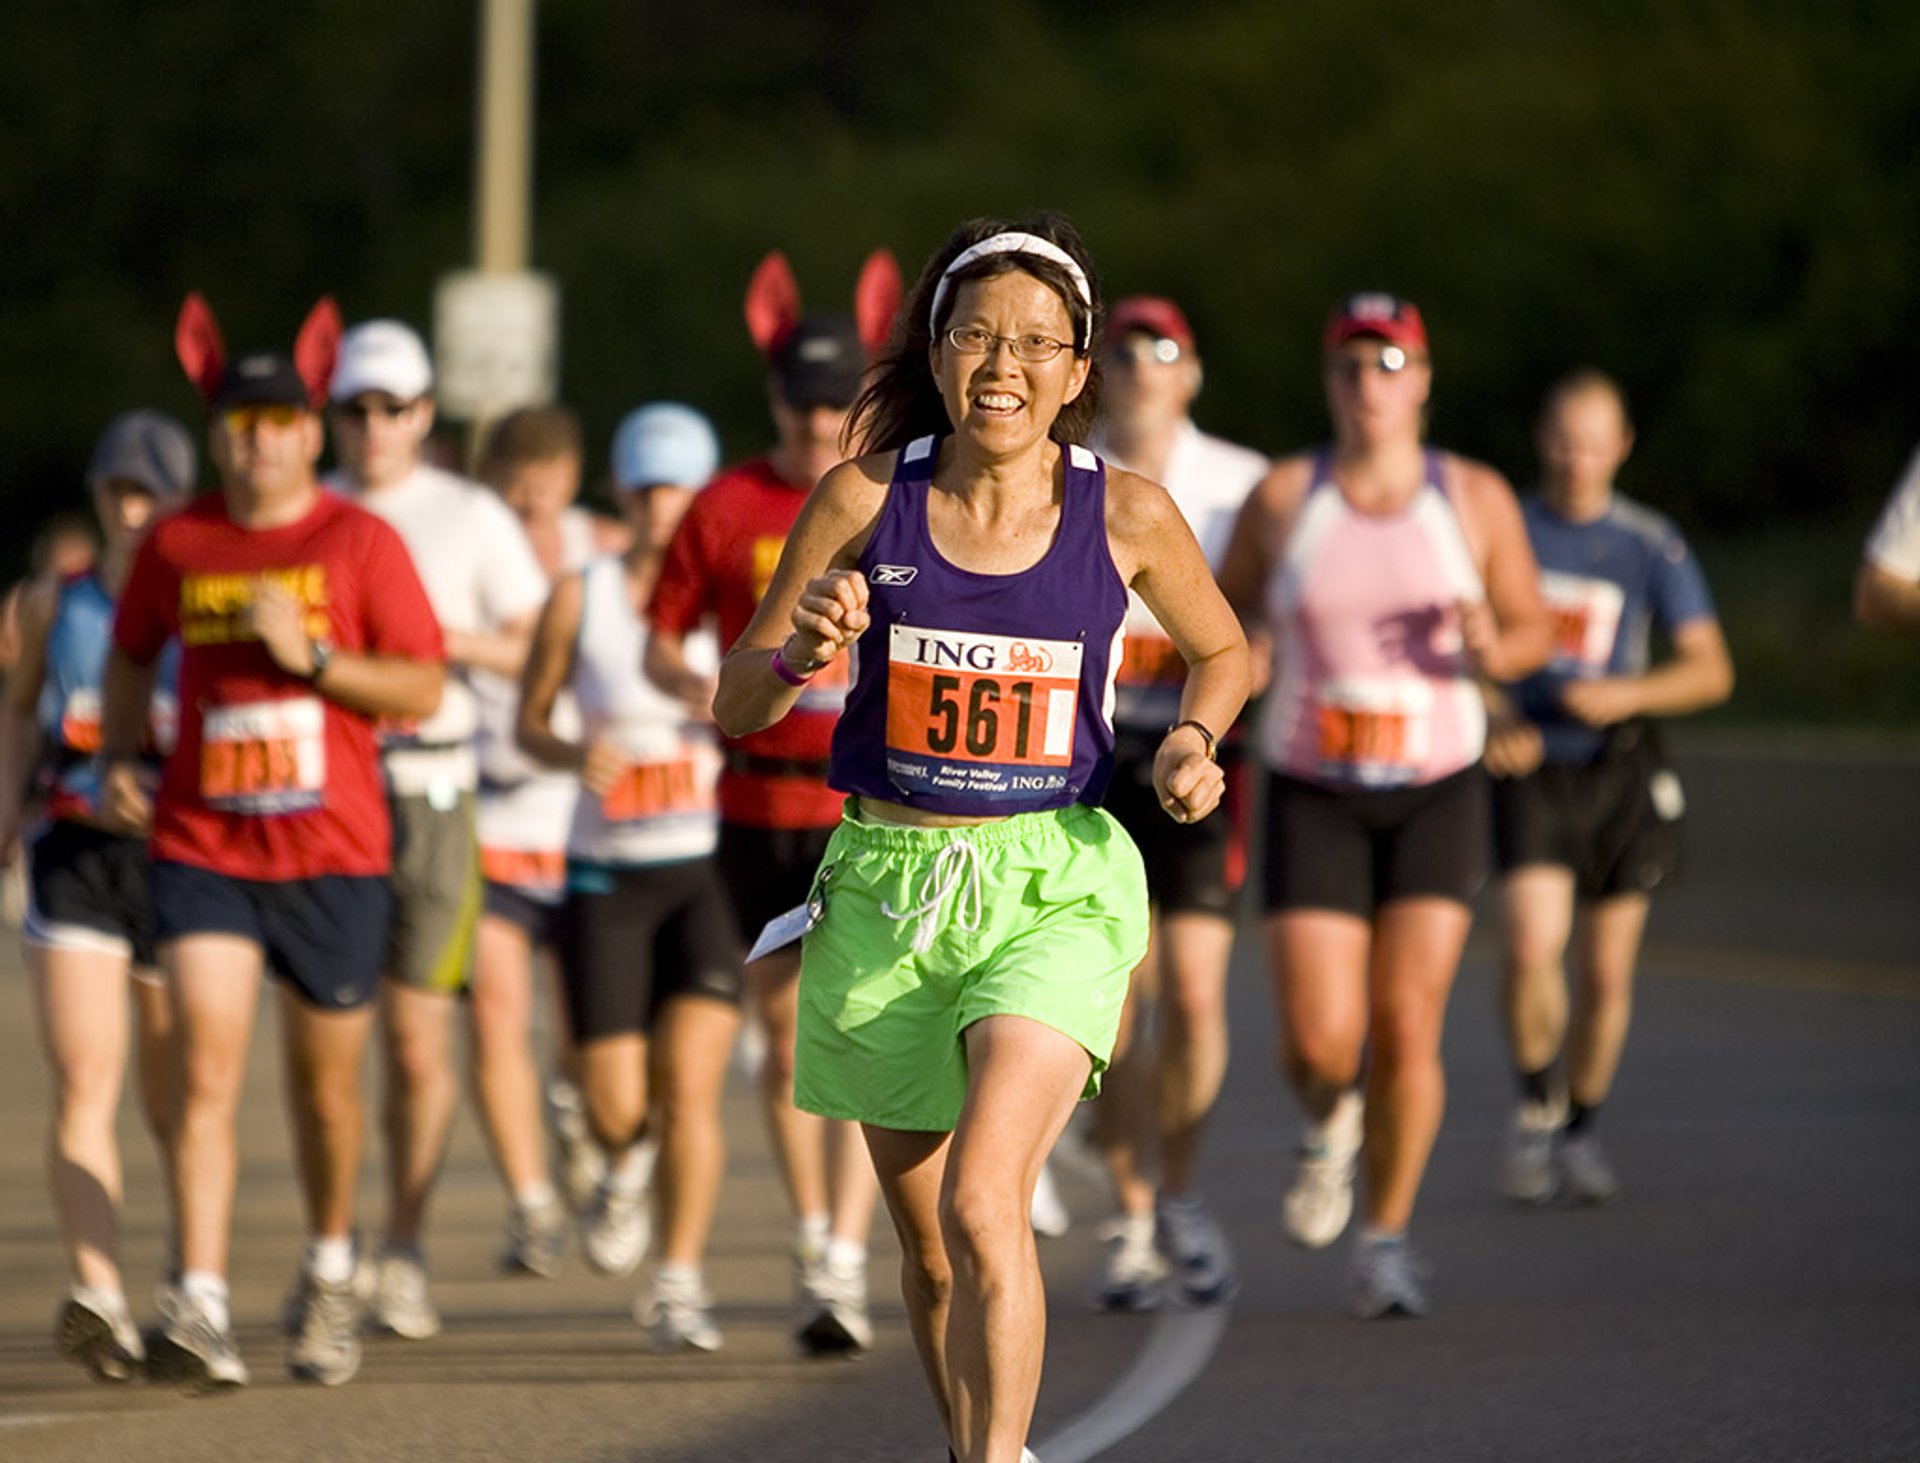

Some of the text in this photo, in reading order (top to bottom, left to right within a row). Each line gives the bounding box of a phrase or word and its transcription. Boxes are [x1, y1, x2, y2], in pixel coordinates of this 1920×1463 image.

[916, 638, 996, 670] ING
[927, 674, 1033, 759] 561
[940, 765, 968, 777] River
[969, 767, 1002, 781] Valley
[932, 776, 1008, 791] Family Festival
[1012, 776, 1044, 789] ING
